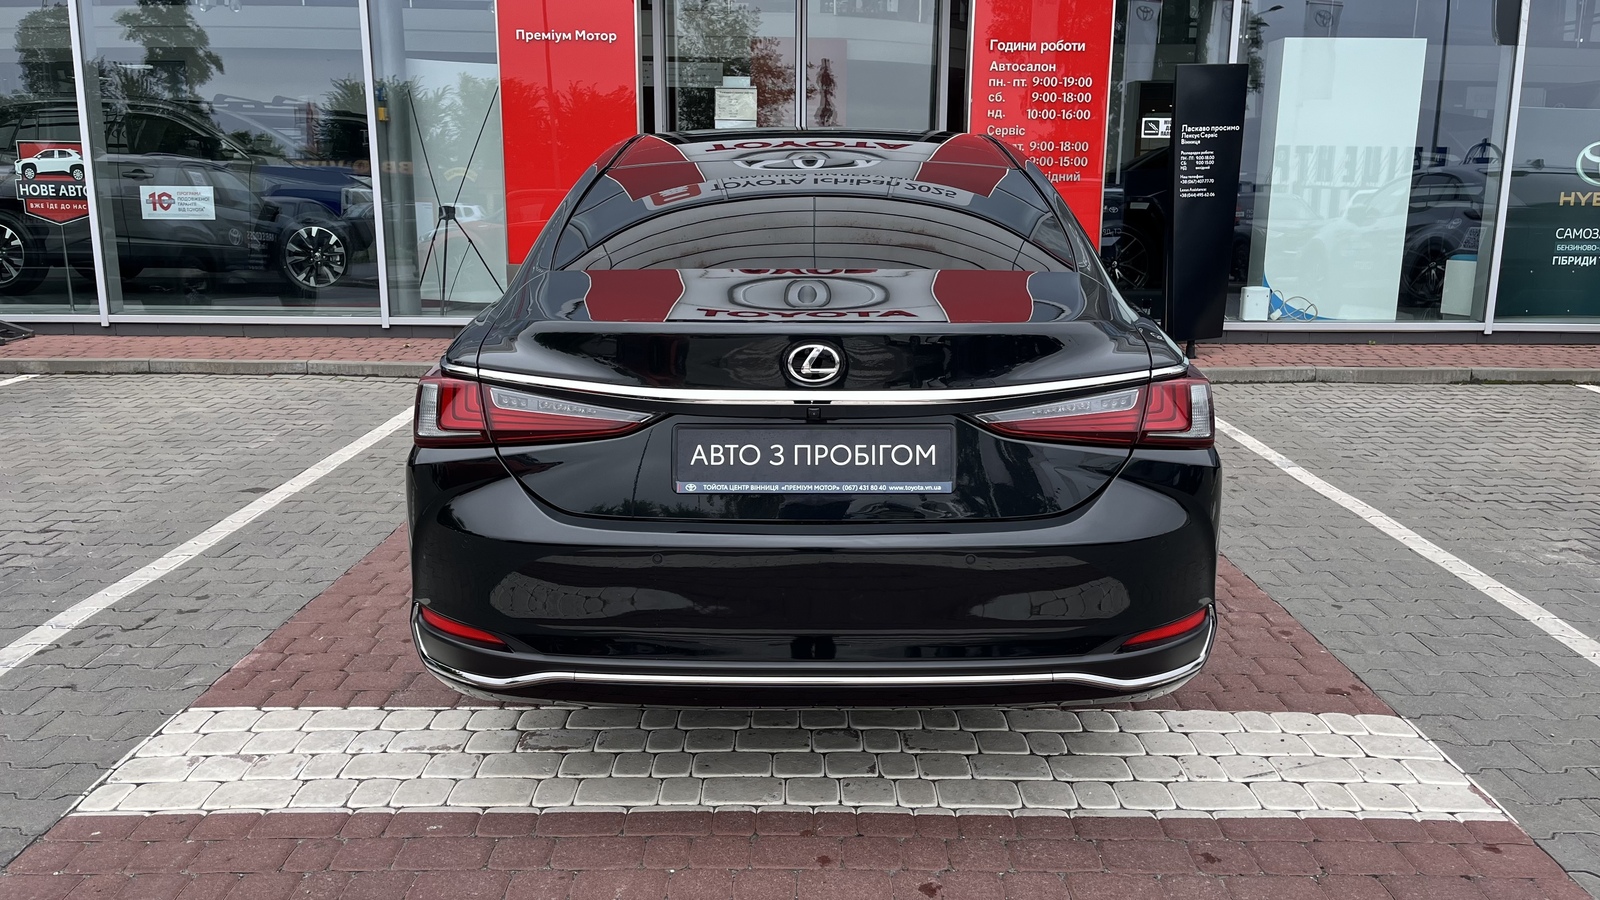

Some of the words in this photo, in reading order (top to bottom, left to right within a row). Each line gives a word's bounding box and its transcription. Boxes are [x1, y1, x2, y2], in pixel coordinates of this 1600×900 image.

[515, 29, 572, 43] Преміум
[575, 30, 617, 44] Мотор
[989, 39, 1037, 53] Години
[1040, 39, 1086, 54] роботи
[989, 61, 1057, 72] Автосалон
[1032, 76, 1093, 88] 9:00-19:00
[988, 92, 1006, 103] сб.
[1031, 92, 1092, 103] 9:00-18:00
[987, 109, 1006, 119] нд.
[1026, 109, 1091, 120] 10:00-16:00
[986, 125, 1026, 138] Сервіс
[1181, 124, 1211, 132] Ласкаво
[20, 184, 56, 196] НОВЕ
[1555, 228, 1600, 239] САМОЗ
[1552, 256, 1597, 267] ГІБРИДИ
[690, 444, 761, 466] АВТО
[794, 444, 936, 466] ПРОБІГОМ
[703, 483, 728, 491] ТОЙОТА
[729, 484, 749, 492] ЦЕНТР
[750, 484, 779, 492] ВІННИЦЯ
[842, 484, 858, 492] (067)
[888, 484, 942, 492] www.toyota.vn.ua
